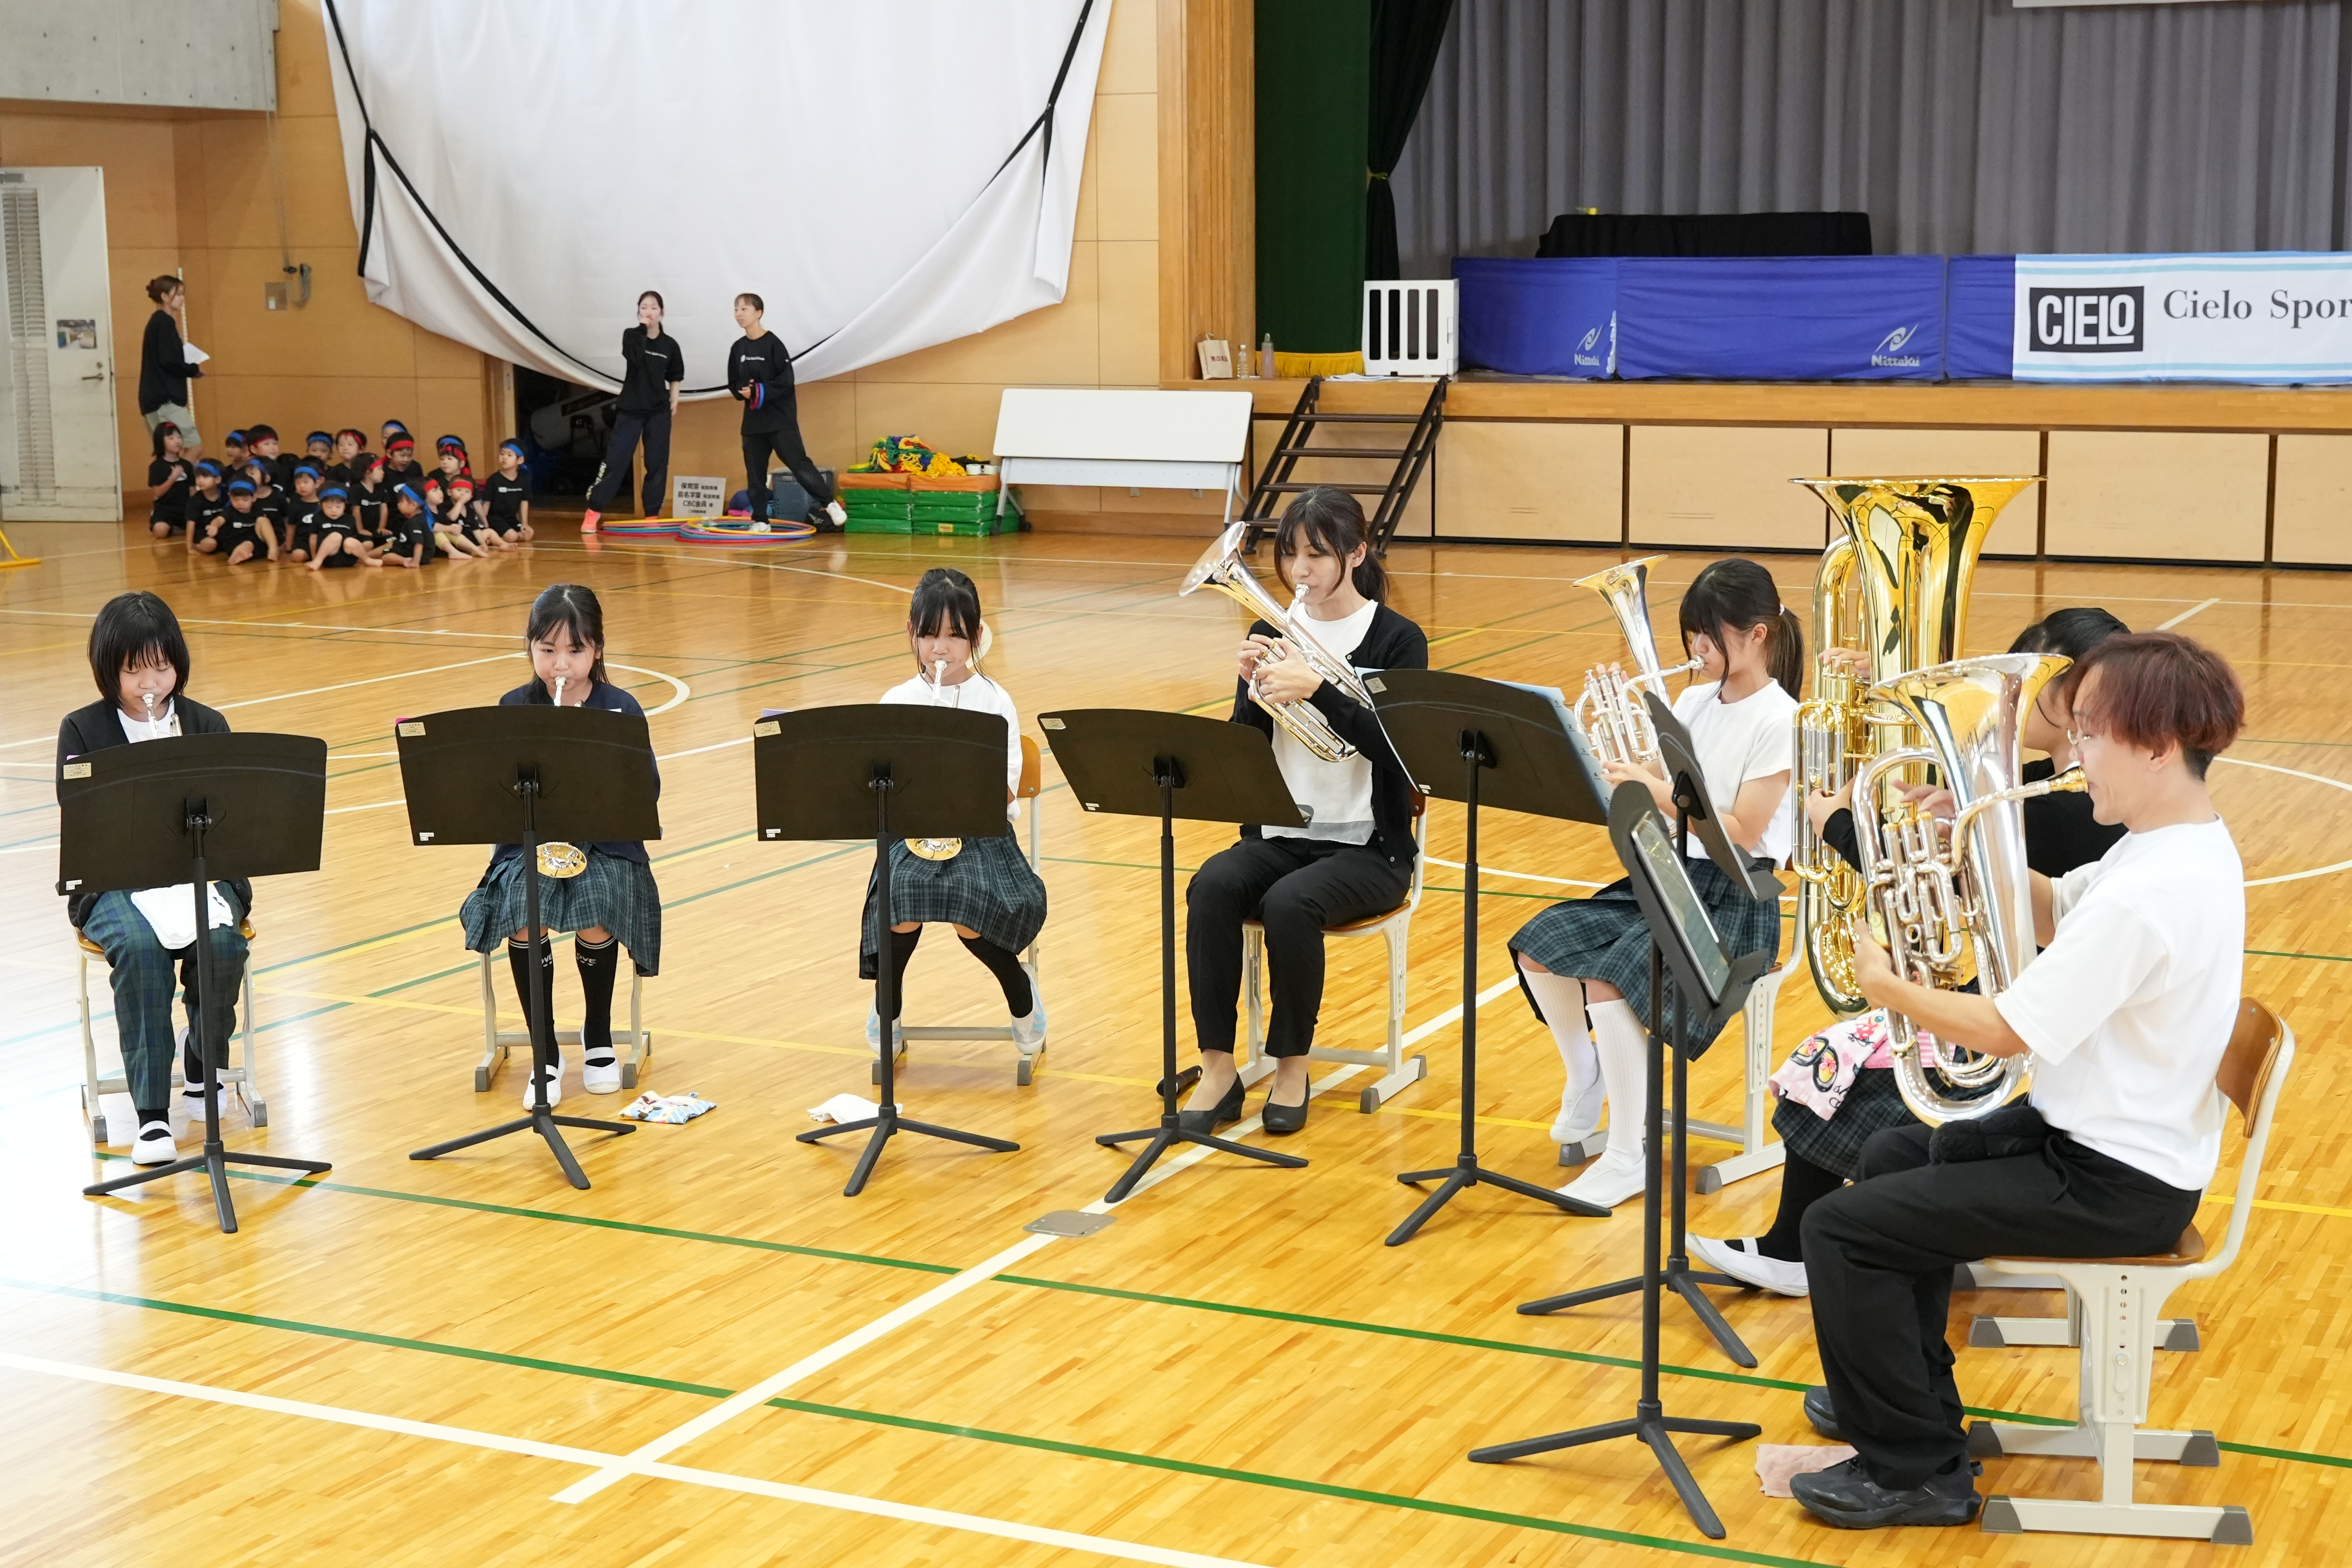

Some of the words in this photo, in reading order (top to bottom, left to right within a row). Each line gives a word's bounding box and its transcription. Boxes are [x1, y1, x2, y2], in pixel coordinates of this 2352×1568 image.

[2037, 294, 2135, 345] CIELO
[2163, 289, 2252, 320] Cielo
[2270, 289, 2352, 329] Spor
[1871, 355, 1920, 366] Nittaku
